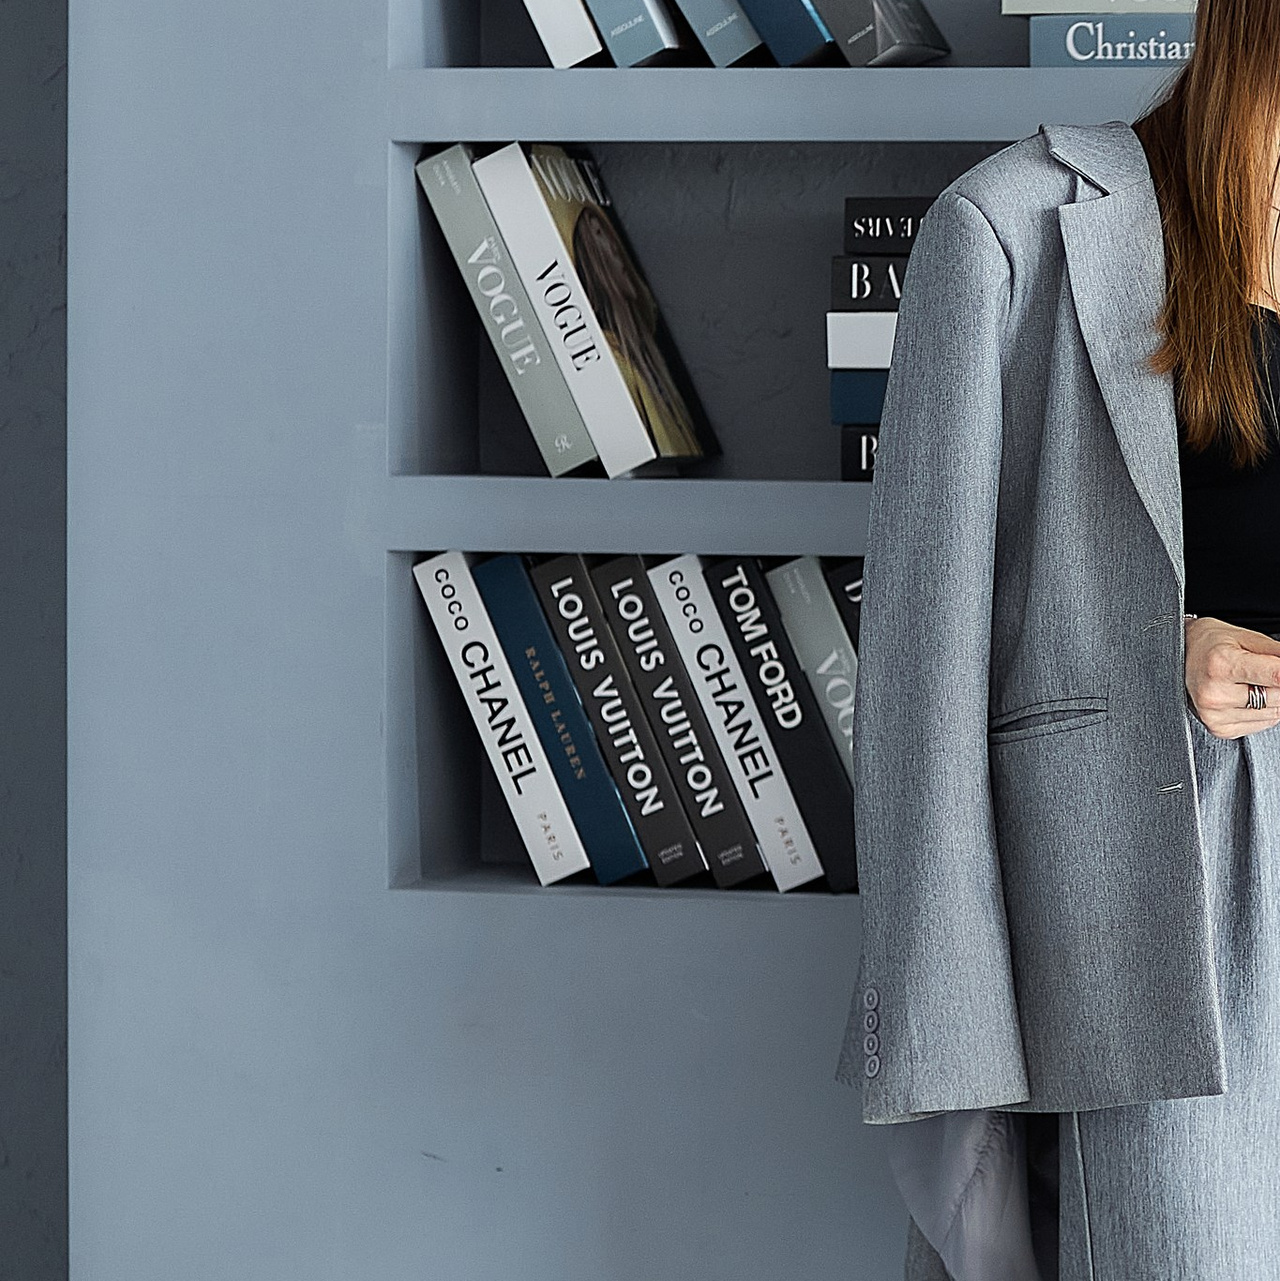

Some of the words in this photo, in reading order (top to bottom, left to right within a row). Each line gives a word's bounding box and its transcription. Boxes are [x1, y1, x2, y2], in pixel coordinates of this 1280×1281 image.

[465, 239, 541, 376] VOGUE
[854, 217, 923, 238] EARS
[535, 259, 601, 373] VOGUE
[434, 568, 469, 631] COCO
[460, 640, 537, 796] CHANEL
[536, 812, 565, 862] PARIS
[524, 646, 553, 705] RALPH
[551, 706, 587, 780] LAUREN
[550, 576, 604, 672] LOUIS
[592, 675, 665, 817] VUITTON
[610, 576, 665, 672] LOUIS
[651, 675, 725, 819] VUITTON
[668, 570, 704, 634] COCO
[696, 643, 774, 800] CHANEL
[774, 816, 802, 867] PARIS
[720, 564, 766, 644] TOM
[749, 641, 803, 731] FORD
